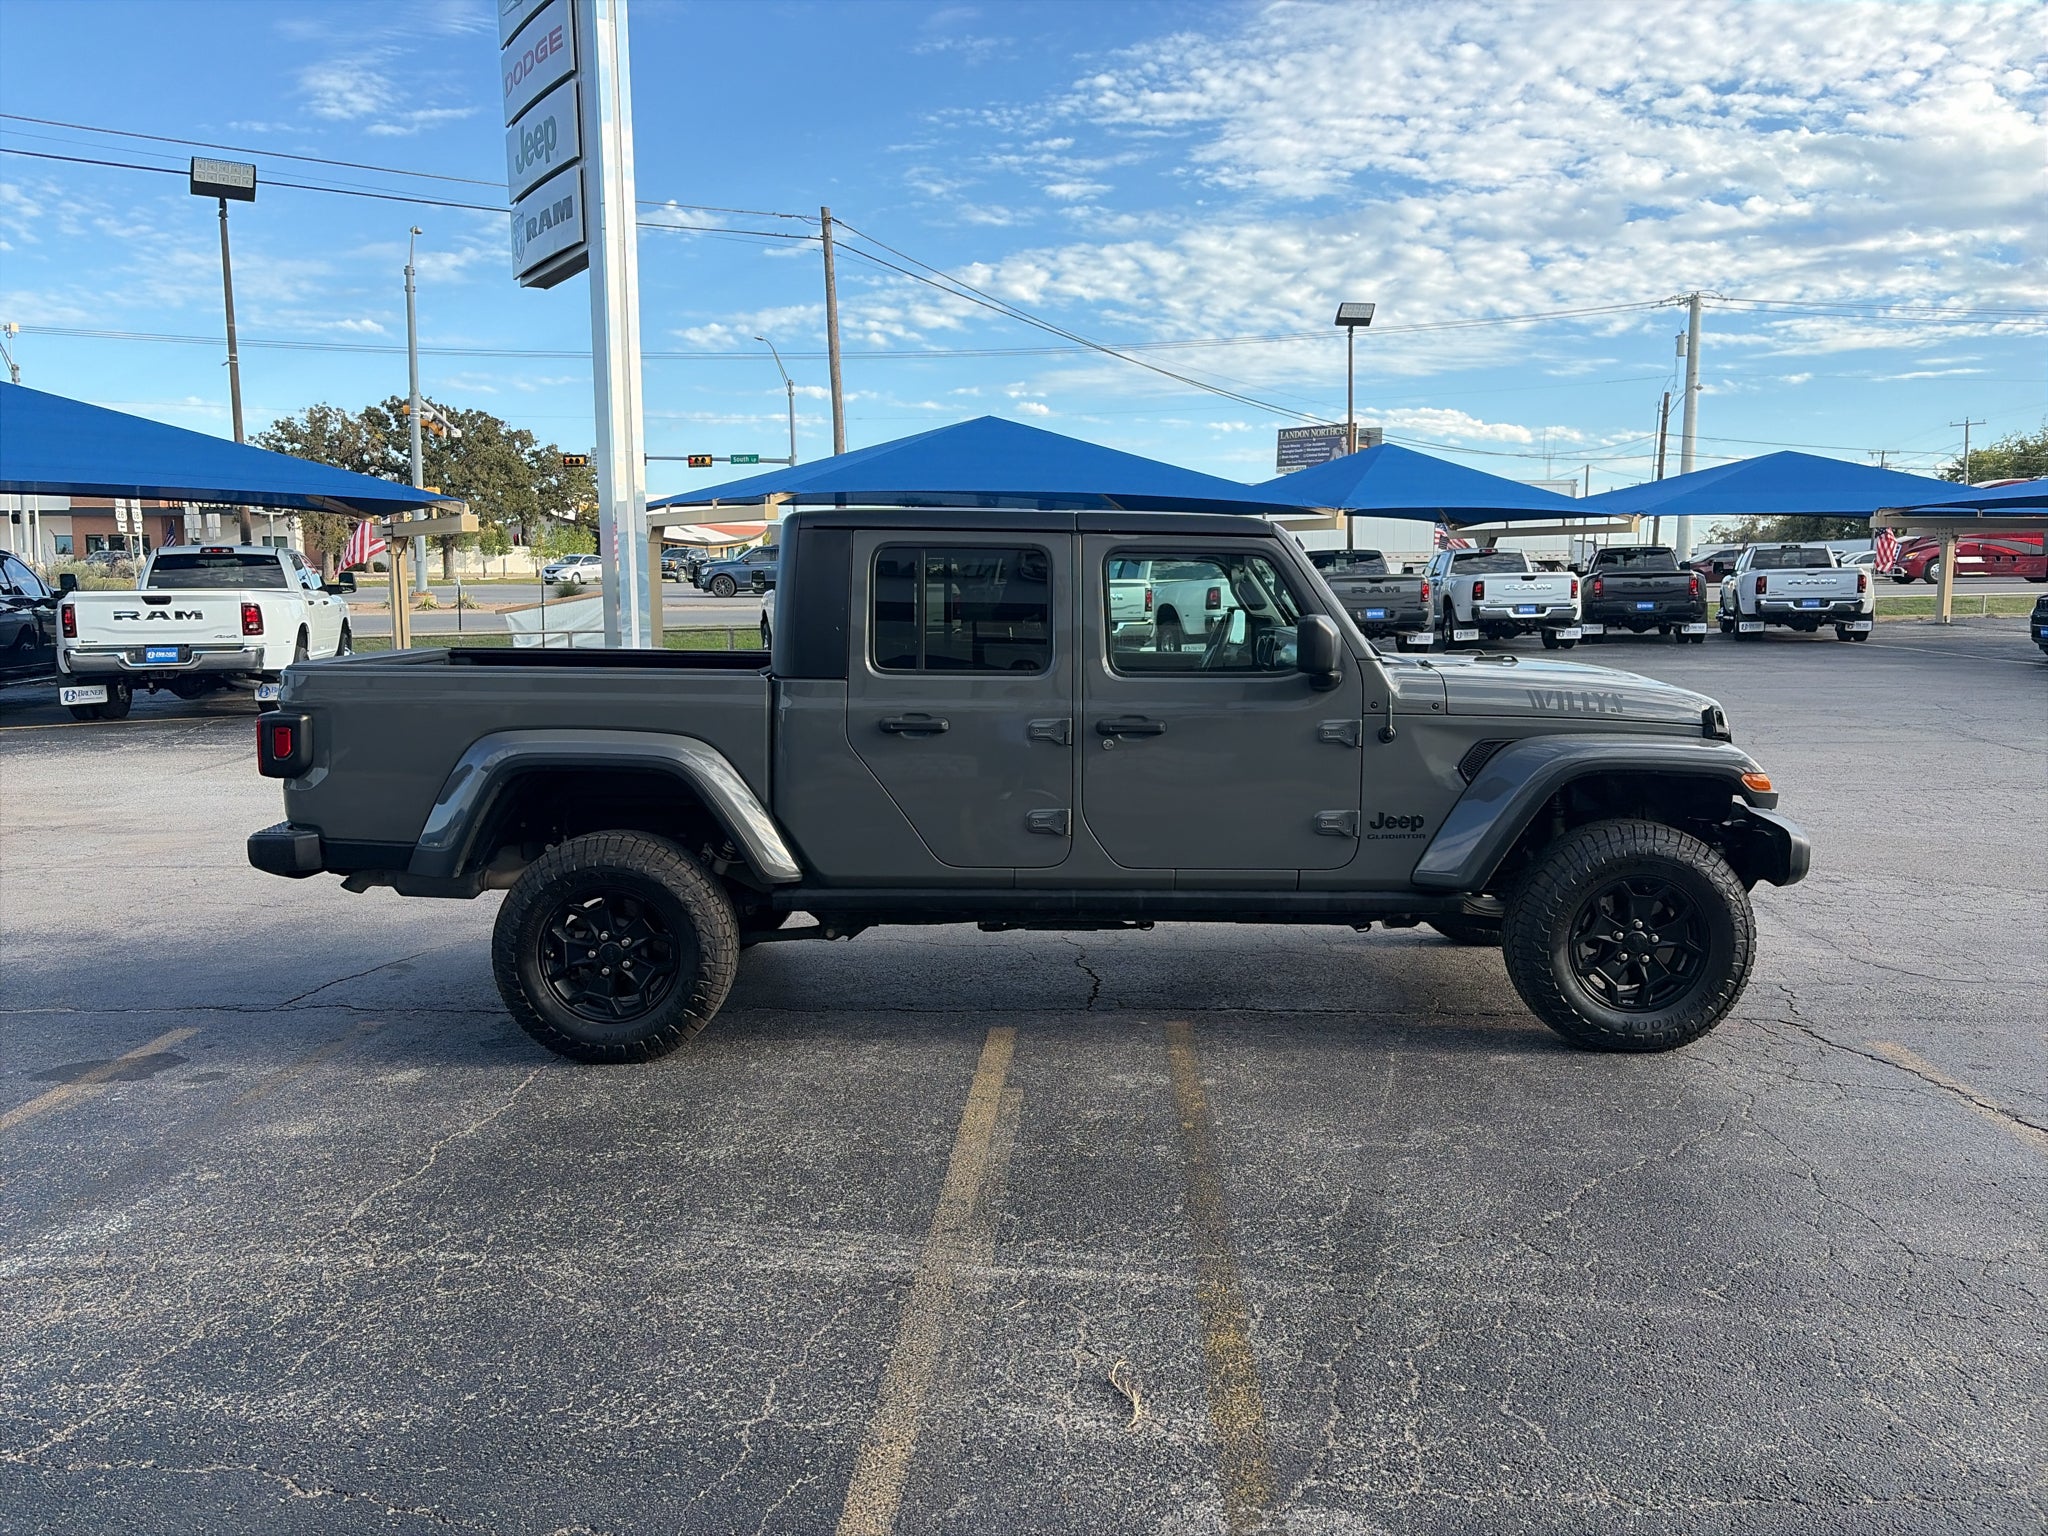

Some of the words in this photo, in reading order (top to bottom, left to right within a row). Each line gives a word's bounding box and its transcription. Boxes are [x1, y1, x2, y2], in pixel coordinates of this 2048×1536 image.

[505, 25, 563, 98] DODGE
[515, 115, 557, 175] Jeep
[526, 195, 573, 243] RAM
[1280, 429, 1310, 439] LANDON
[1351, 586, 1401, 594] RAM
[1504, 583, 1552, 591] RAM
[113, 610, 203, 621] RAM
[1525, 689, 1624, 713] WILLYS
[1370, 811, 1425, 832] Jeep
